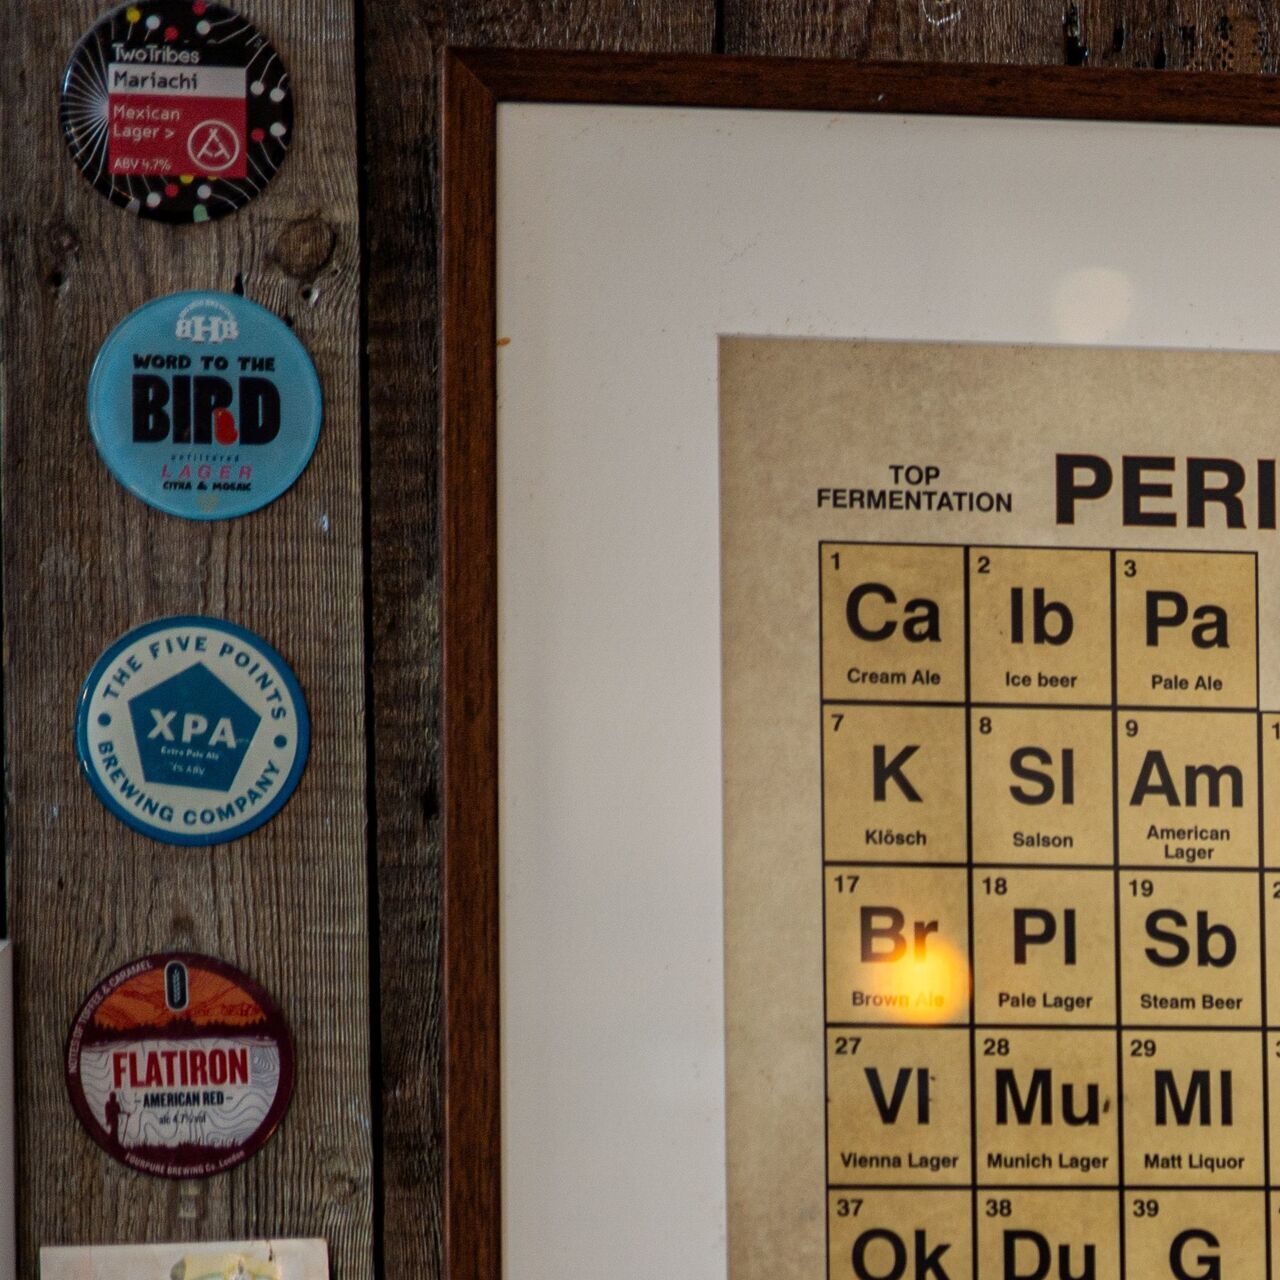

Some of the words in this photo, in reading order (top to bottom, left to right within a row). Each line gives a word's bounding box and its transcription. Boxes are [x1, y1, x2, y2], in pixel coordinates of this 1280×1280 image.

[113, 71, 198, 90] Mariachi
[113, 105, 180, 120] Mexican
[113, 125, 159, 142] Lager
[133, 354, 191, 370] WORD
[201, 358, 228, 371] TO
[238, 357, 275, 371] THE
[132, 374, 281, 445] BIRD
[889, 465, 940, 484] TOP
[817, 489, 1013, 512] FERMENTATION
[846, 582, 941, 643] Ca
[1011, 587, 1073, 646] Ib
[1146, 590, 1229, 649] Pa
[848, 668, 906, 684] Cream
[912, 670, 940, 685] Ale
[1006, 672, 1031, 686] Ice
[1038, 672, 1077, 687] beer
[1152, 675, 1188, 689] Pale
[1195, 676, 1222, 690] Ale
[147, 709, 237, 749] XPA
[873, 745, 923, 802] K
[1130, 750, 1243, 807] Am
[113, 1049, 248, 1088] FLATIRON
[143, 1092, 199, 1108] AMERICAN
[203, 1091, 224, 1106] RED
